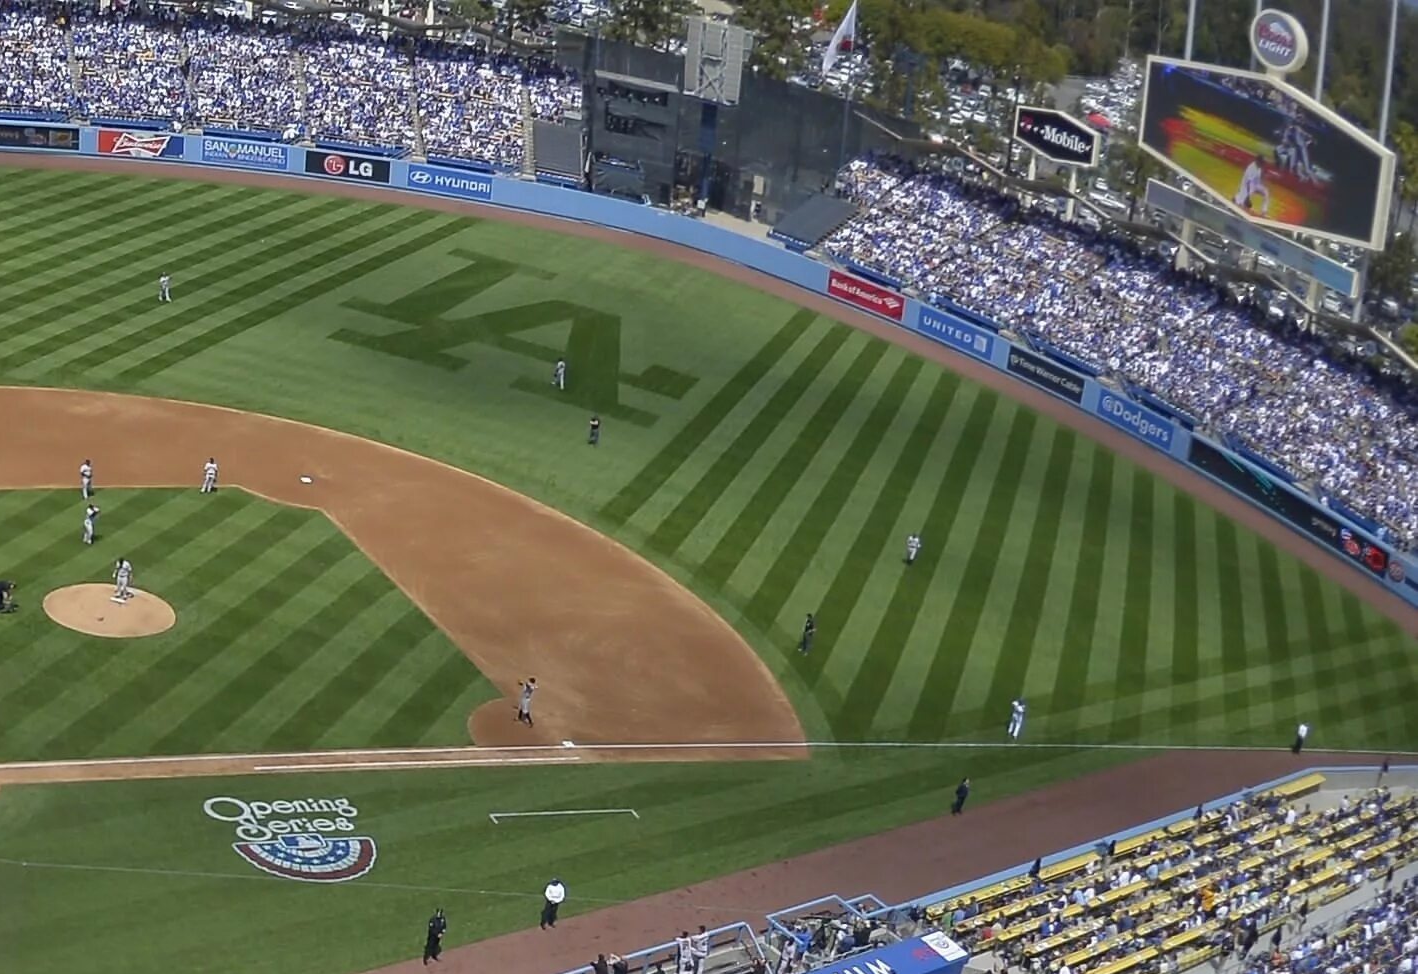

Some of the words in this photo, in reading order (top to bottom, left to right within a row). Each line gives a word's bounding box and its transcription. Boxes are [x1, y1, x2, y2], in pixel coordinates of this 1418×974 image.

[1258, 39, 1292, 57] LIGHT
[205, 140, 229, 153] SAN
[237, 143, 285, 159] MANUEL
[348, 161, 373, 177] LG
[434, 175, 491, 193] HYUNDAI
[923, 315, 973, 344] UNITED
[1102, 395, 1169, 442] @Dodgers
[203, 796, 359, 823] Opening
[236, 817, 355, 841] Series
